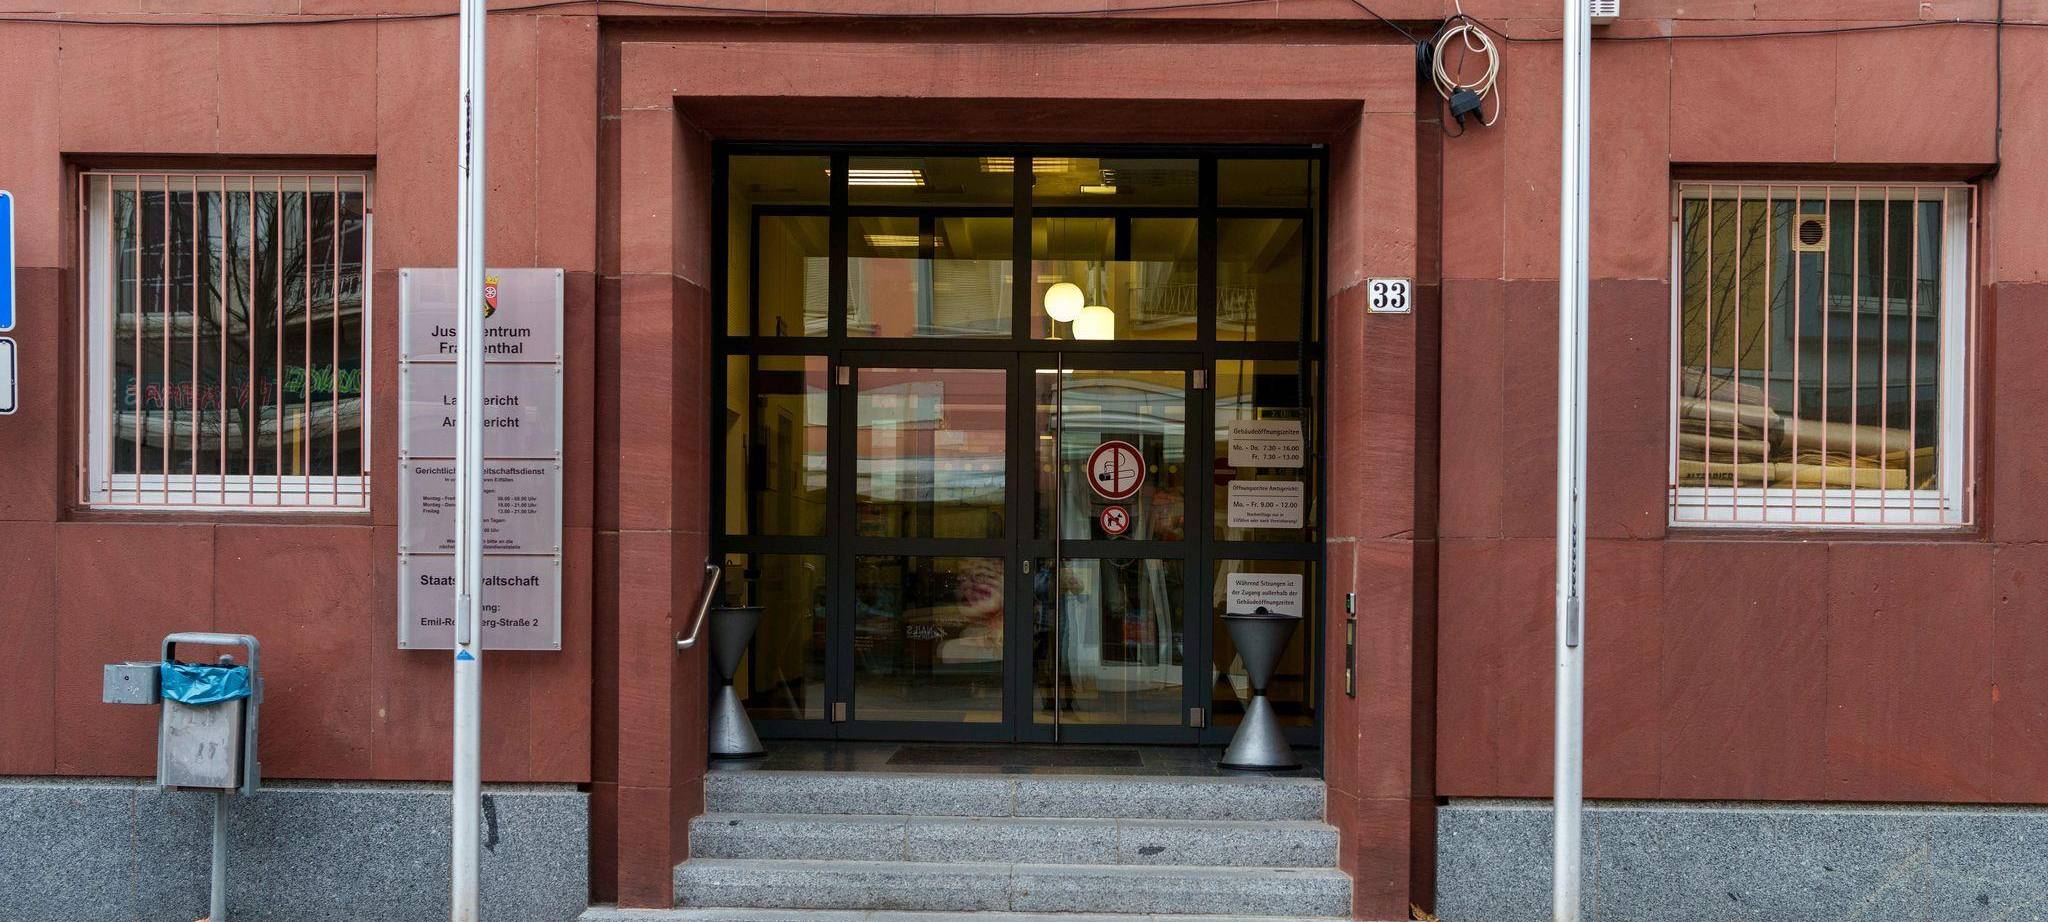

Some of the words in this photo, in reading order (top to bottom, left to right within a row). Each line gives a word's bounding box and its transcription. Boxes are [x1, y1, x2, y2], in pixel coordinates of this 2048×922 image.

[1374, 282, 1405, 308] 33
[432, 326, 530, 337] Jusentrum
[440, 342, 523, 354] Fraenthal
[444, 395, 519, 405] Laericht
